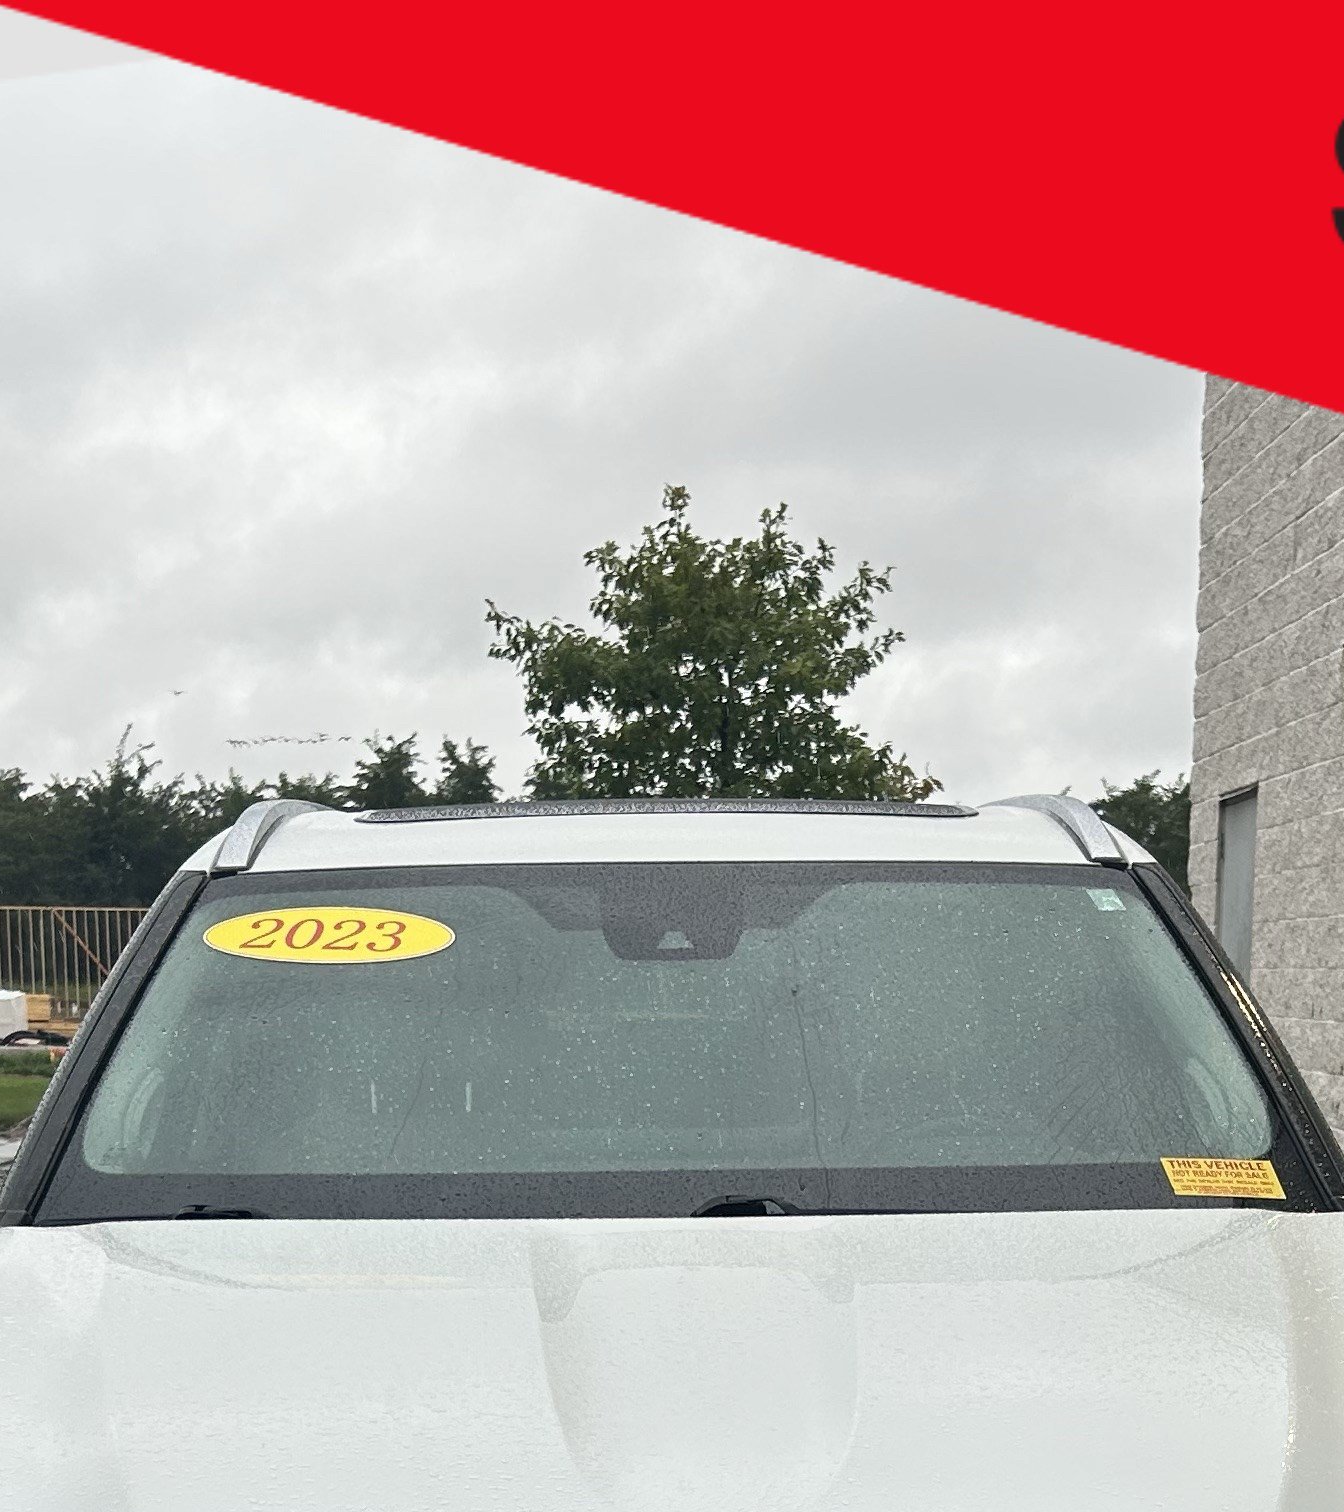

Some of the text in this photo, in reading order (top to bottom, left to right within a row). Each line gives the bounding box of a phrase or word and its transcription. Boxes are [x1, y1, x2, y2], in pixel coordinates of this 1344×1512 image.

[239, 918, 406, 952] 2023
[1167, 1160, 1268, 1171] THIS VEHICLE
[1193, 1170, 1222, 1178] READY
[1225, 1171, 1243, 1179] FOR
[1245, 1172, 1269, 1180] SALE
